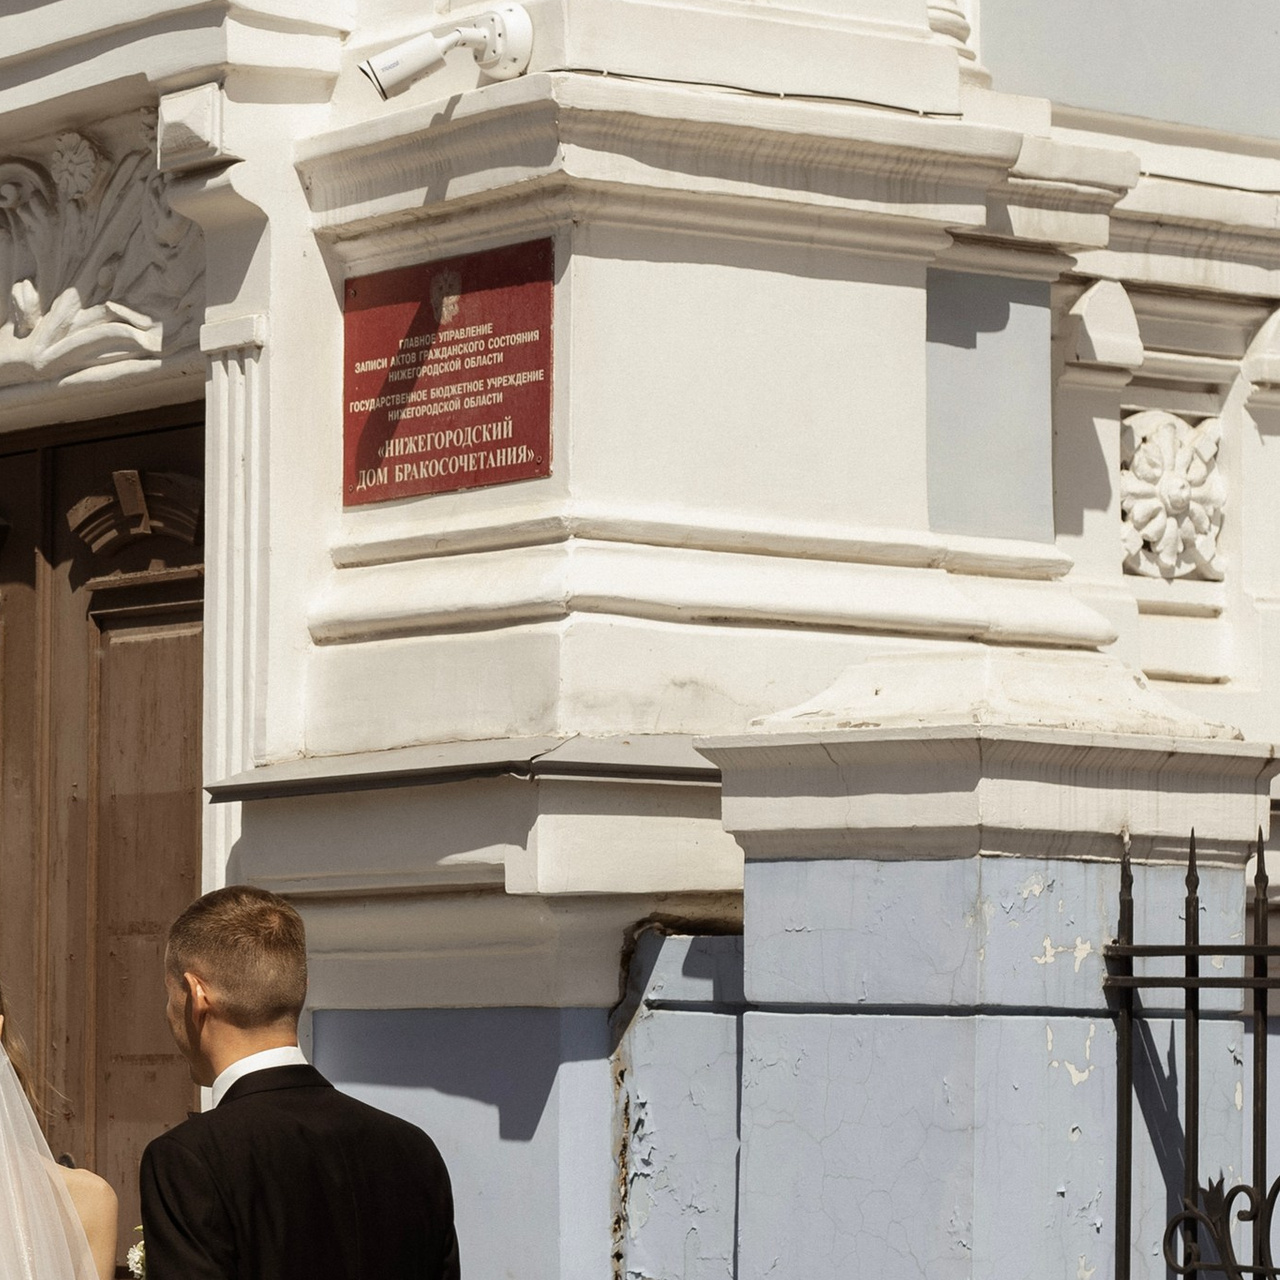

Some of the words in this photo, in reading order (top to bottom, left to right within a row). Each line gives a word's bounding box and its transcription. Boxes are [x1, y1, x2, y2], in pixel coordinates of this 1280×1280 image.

[355, 356, 388, 374] ЗАПИСИ
[390, 352, 417, 368] АКТОВ
[419, 340, 486, 361] ГРАЖДАНСКОГО
[488, 330, 540, 349] СОСТОЯНИЯ
[399, 333, 437, 350] ГЛАВНОЕ
[438, 323, 493, 343] УПРАВЛЕНИЕ
[388, 357, 462, 382] НИЖЕГОРОДСКОЙ
[464, 352, 504, 369] ОБЛАСТИ
[349, 389, 428, 413] ГОСУДАРСТВЕННОЕ
[430, 379, 484, 399] БЮДЖЕТНОЕ
[487, 369, 545, 390] УЧРЕЖДЕНИЕ
[387, 397, 461, 422] НИЖЕГОРОДСКОЙ
[463, 392, 503, 409] ОБЛАСТИ
[377, 415, 514, 458] «НИЖЕГОРОДСКИЙ
[356, 467, 389, 492] ДОМ
[395, 445, 535, 483] БРАКОСОЧЕТАНИЯ»
